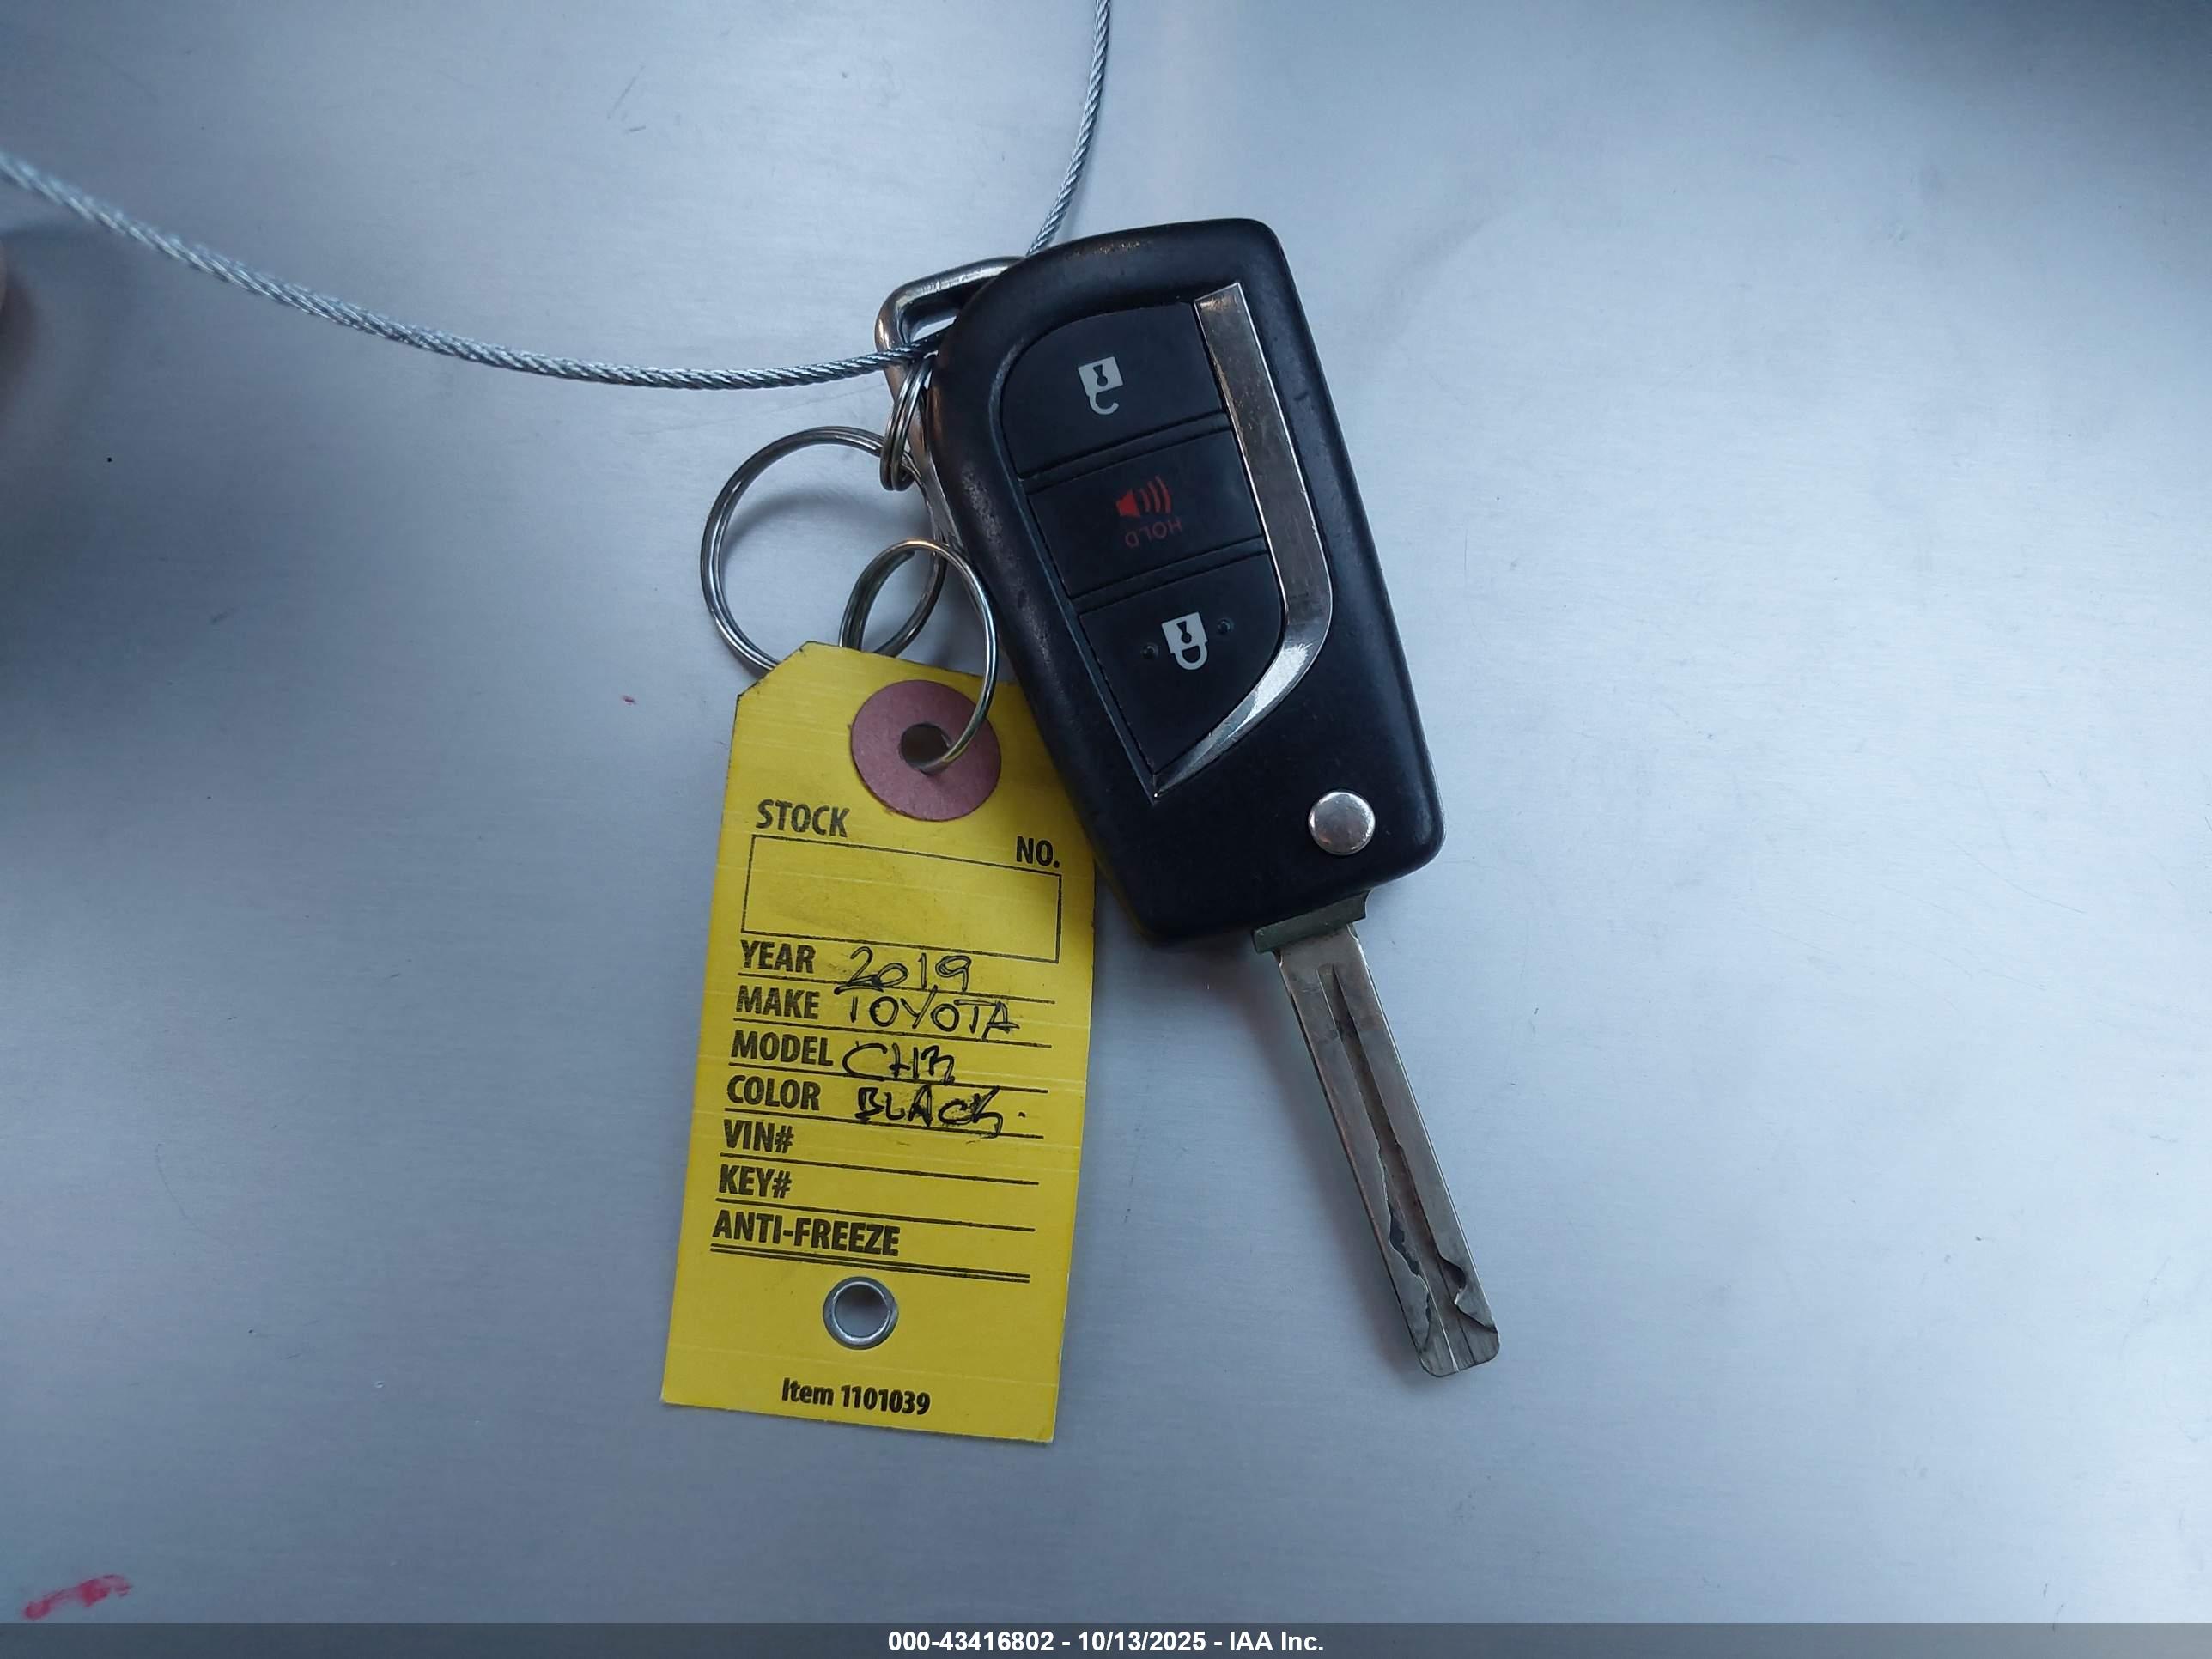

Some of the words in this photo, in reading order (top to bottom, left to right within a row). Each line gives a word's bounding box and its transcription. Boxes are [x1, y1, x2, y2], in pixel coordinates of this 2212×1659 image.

[1125, 518, 1182, 549] HOLD
[755, 799, 850, 838] STOCK
[1016, 836, 1061, 868] NO.
[740, 939, 816, 975] YEAR
[848, 945, 972, 993] 2019
[736, 984, 821, 1020] MAKE
[835, 984, 1020, 1042] TOYOTA
[731, 1030, 834, 1066] MODEL
[726, 1074, 821, 1111] COLOR
[723, 1119, 794, 1153] VIN#
[719, 1164, 793, 1199] KEY#
[712, 1209, 902, 1257] ANTI-FREEZE
[781, 1377, 834, 1406] Item
[841, 1384, 931, 1415] 1101039
